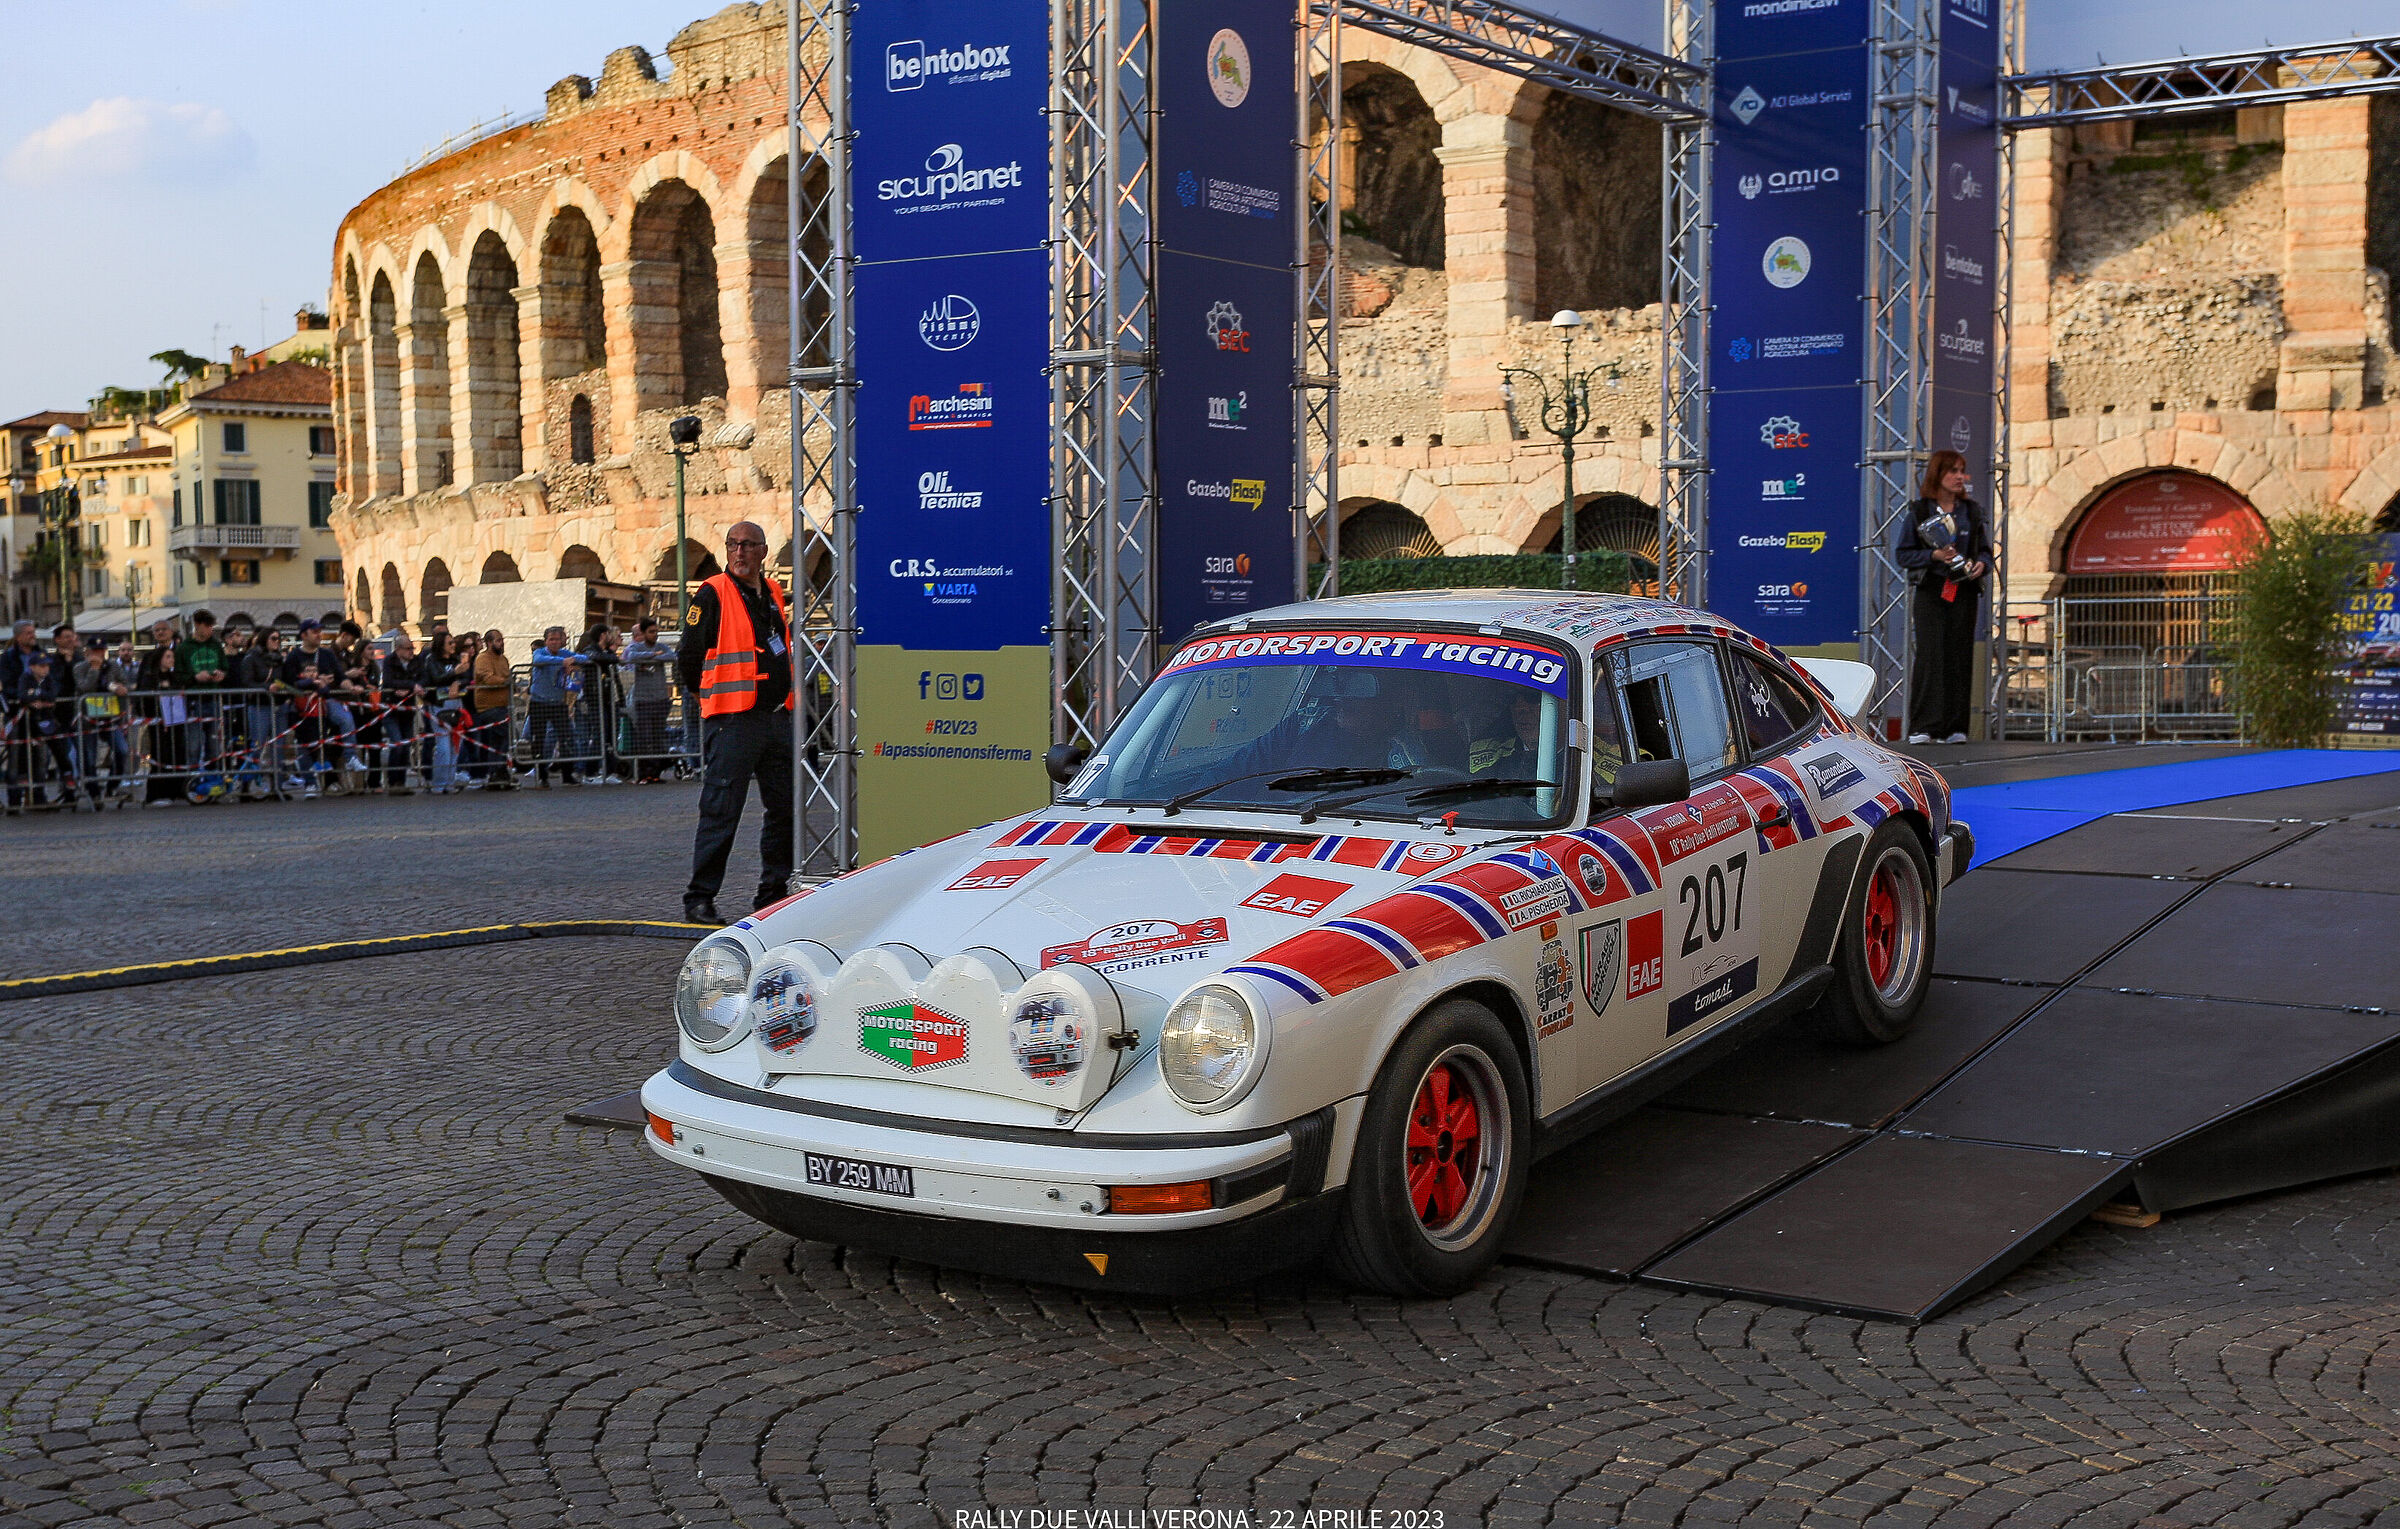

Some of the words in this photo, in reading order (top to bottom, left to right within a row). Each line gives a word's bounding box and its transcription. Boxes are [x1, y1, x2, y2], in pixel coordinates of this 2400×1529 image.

[890, 44, 1010, 80] bentobox
[1789, 93, 1818, 106] Global
[877, 158, 1022, 200] sicurplanet
[1768, 167, 1839, 187] amia
[894, 206, 918, 215] YOUR
[920, 201, 962, 212] SECURITY
[963, 198, 1005, 208] PARTNER
[1219, 328, 1251, 353] SEC
[909, 395, 992, 422] Marchesini
[1774, 433, 1810, 449] SEC
[920, 491, 983, 510] Tecnica
[890, 558, 941, 578] C.R.S.
[942, 565, 1003, 576] accumulatori
[1205, 557, 1234, 573] sara
[937, 583, 978, 596] VARTA
[1758, 584, 1790, 597] sara
[1167, 634, 1417, 670] MOTORSPORT
[1423, 641, 1565, 685] racing
[925, 720, 978, 735] #R2V23
[873, 741, 1032, 761] #lapassionenonsiferma
[1680, 834, 1696, 851] Rally
[951, 874, 1020, 888] EAE
[1246, 892, 1324, 915] EAE
[1520, 910, 1528, 921] A.
[1528, 894, 1569, 918] PISCHEDDA
[1680, 851, 1748, 959] 207
[1111, 923, 1155, 938] 207
[1103, 944, 1134, 954] Rally
[1135, 940, 1159, 949] Due
[1160, 934, 1187, 945] Valli
[1629, 957, 1661, 993] EAE
[864, 1015, 962, 1037] MOTORSPORT
[888, 1037, 938, 1055] racing
[807, 1156, 834, 1183] BY
[837, 1161, 871, 1188] 259
[875, 1166, 911, 1194] MM
